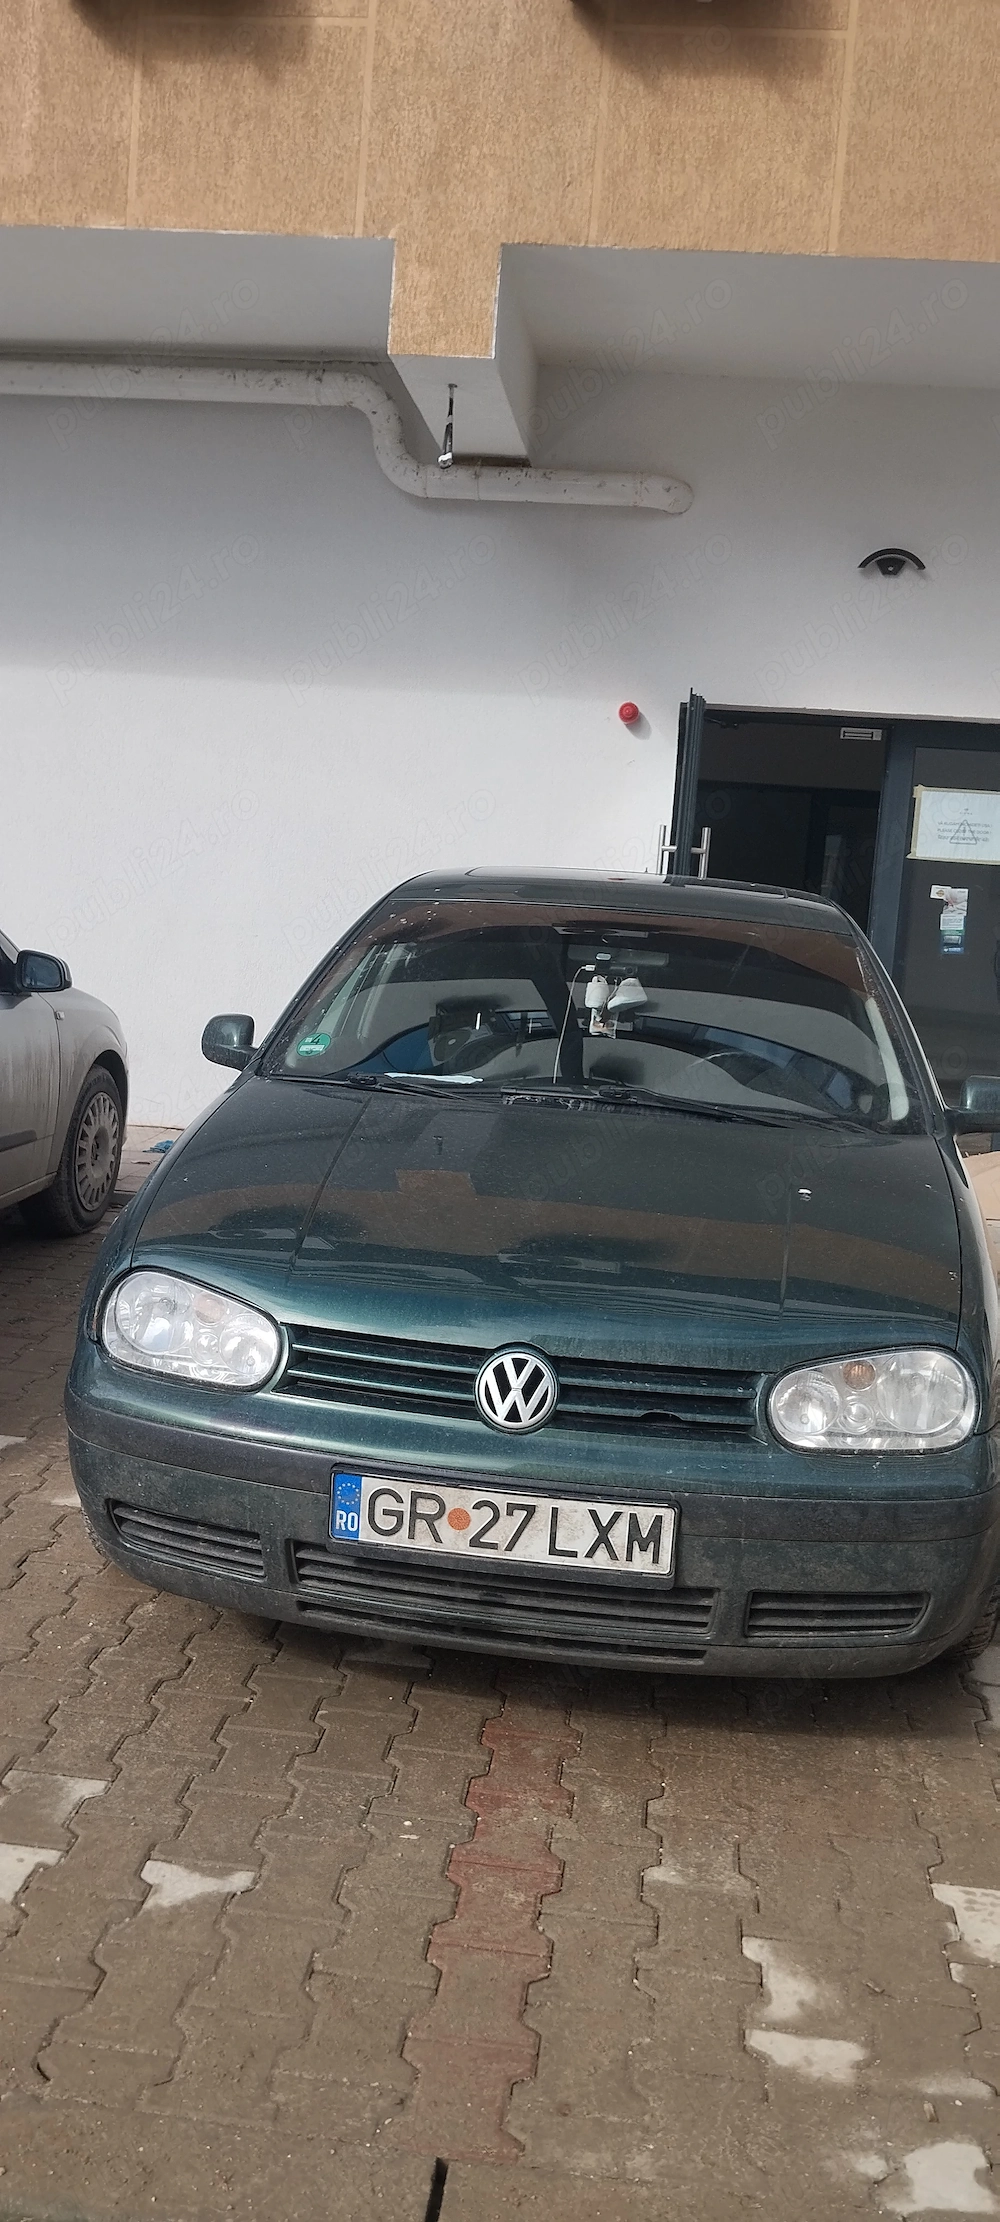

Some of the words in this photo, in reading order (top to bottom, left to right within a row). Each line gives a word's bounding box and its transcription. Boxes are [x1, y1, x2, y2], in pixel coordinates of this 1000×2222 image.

[478, 1351, 556, 1429] VW
[335, 1509, 359, 1532] RO
[367, 1486, 446, 1544] GR
[468, 1500, 537, 1552] 27
[547, 1506, 664, 1565] LXM
